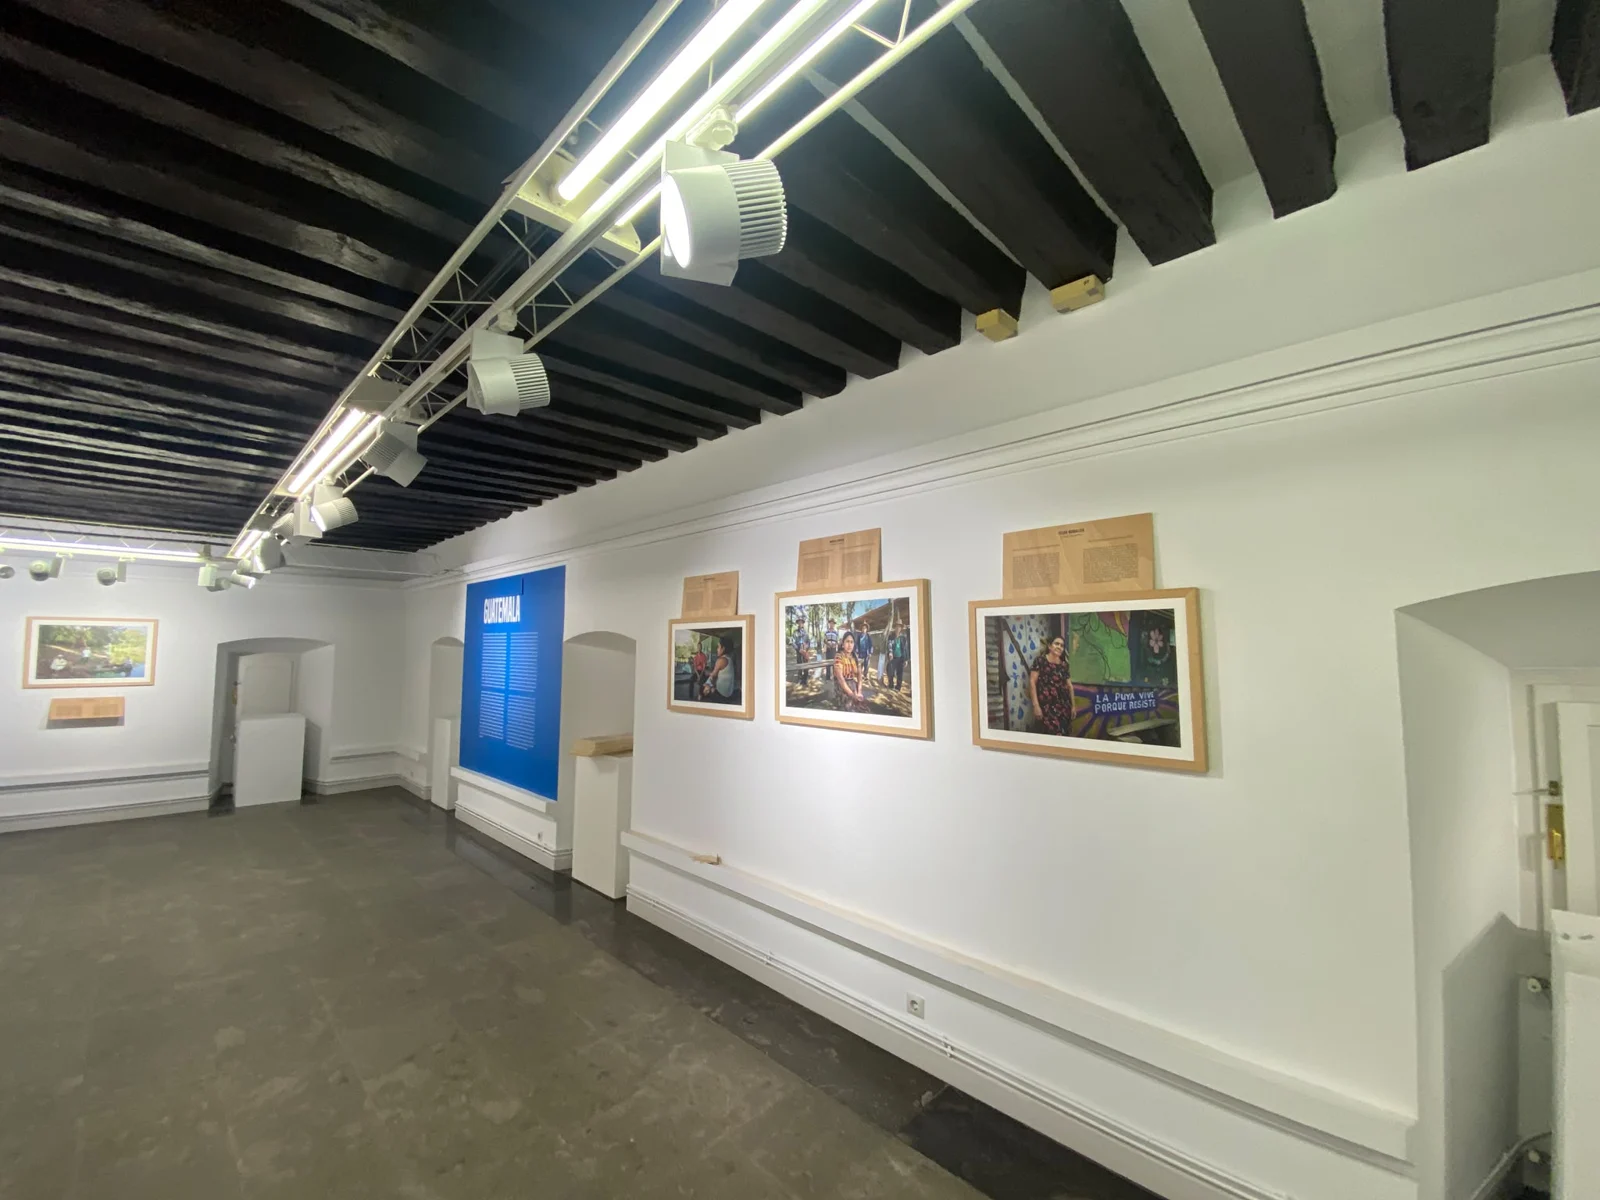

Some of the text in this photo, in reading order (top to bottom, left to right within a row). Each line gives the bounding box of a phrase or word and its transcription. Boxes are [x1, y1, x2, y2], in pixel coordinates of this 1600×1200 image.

[483, 595, 520, 624] GUATEMALA
[1096, 691, 1154, 703] LA PUYA VIVE
[1094, 699, 1156, 714] PORQUE RESISTE
